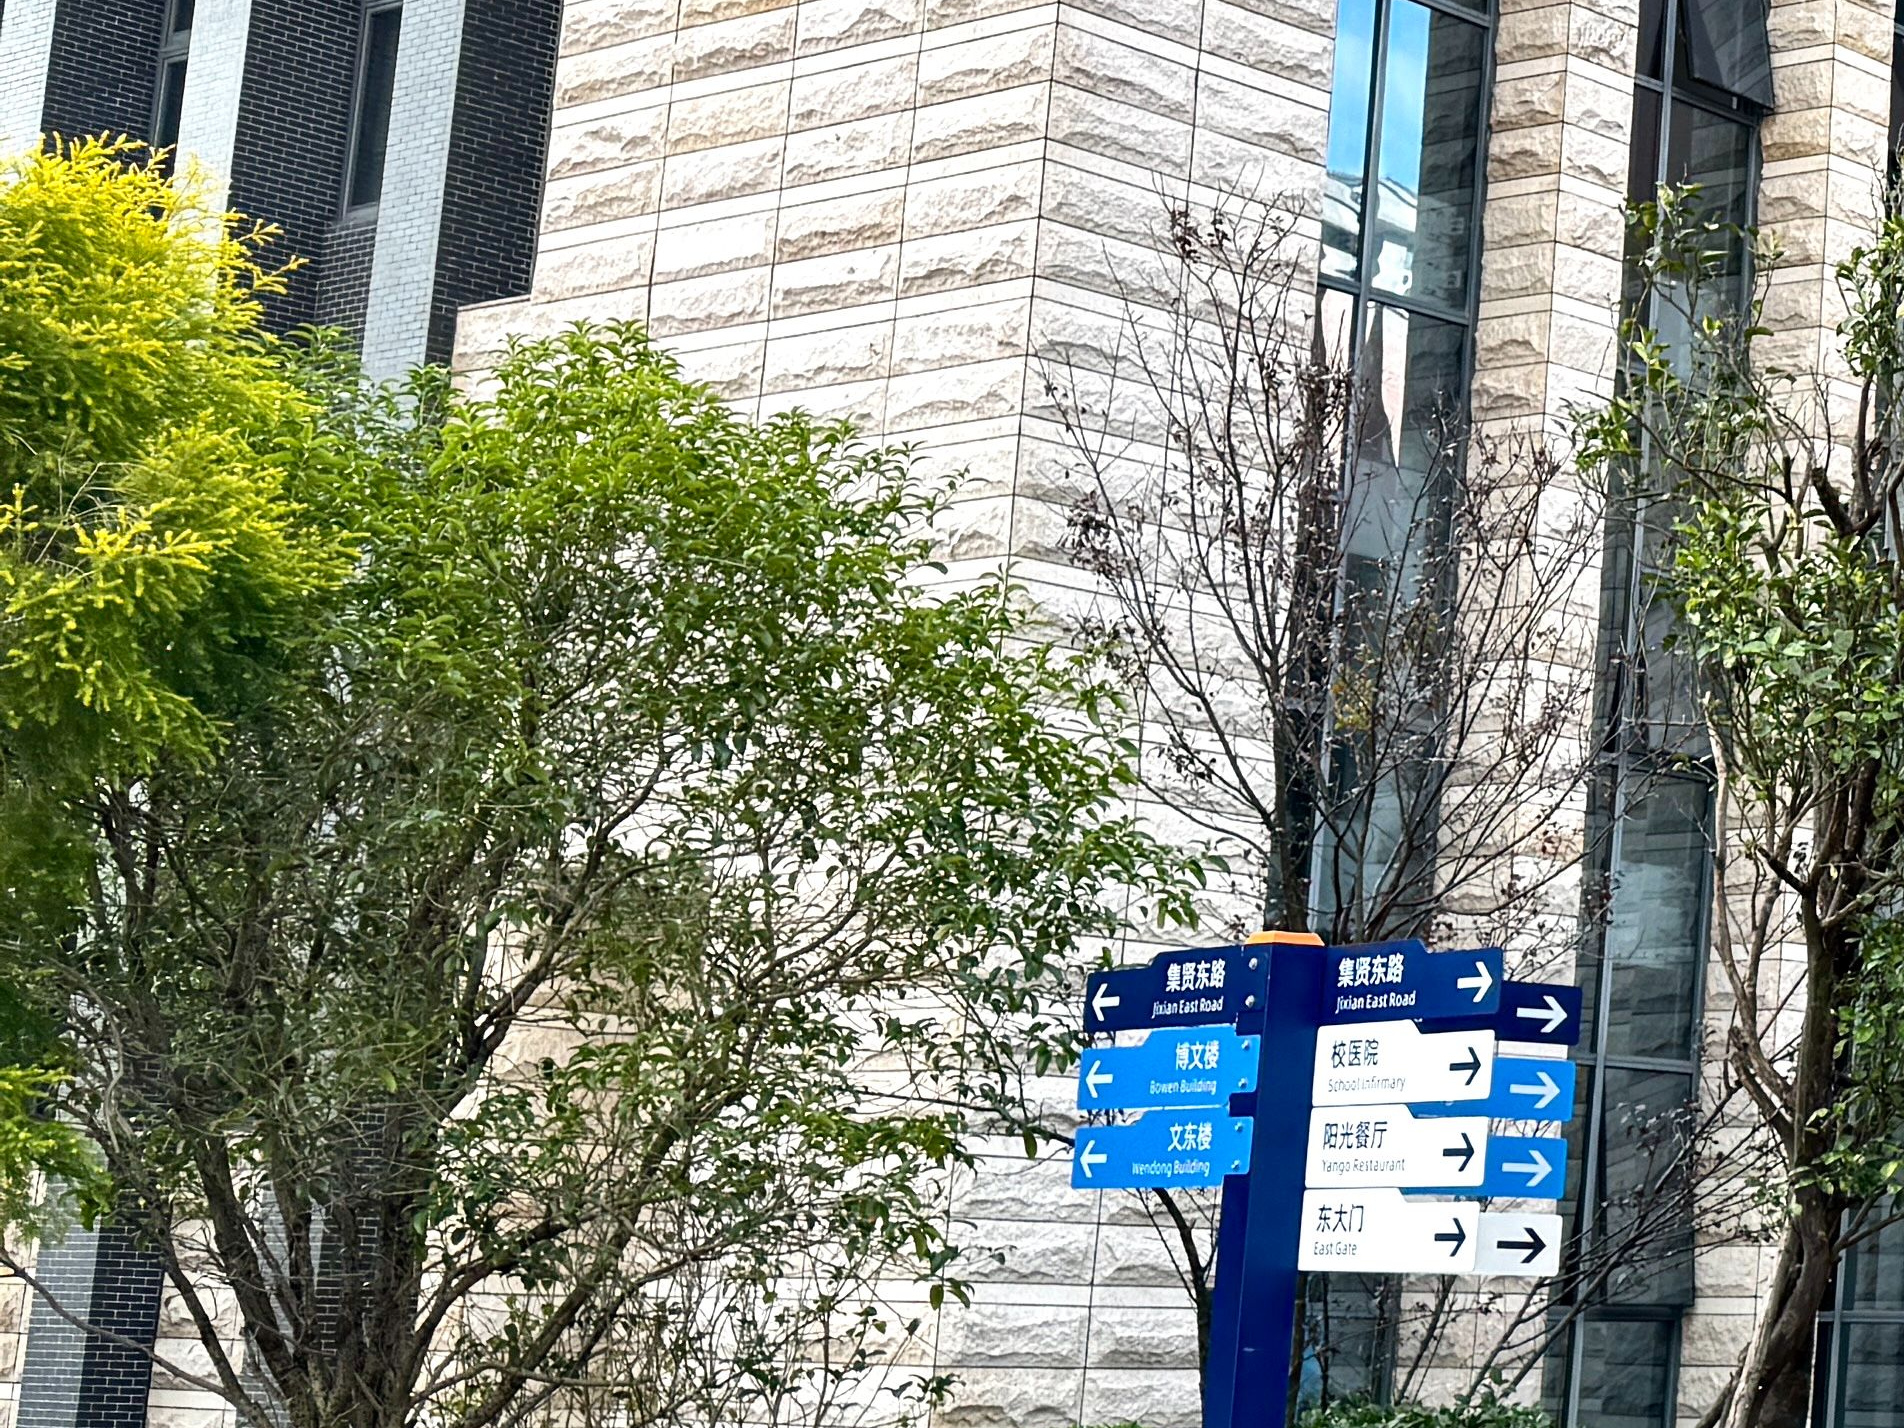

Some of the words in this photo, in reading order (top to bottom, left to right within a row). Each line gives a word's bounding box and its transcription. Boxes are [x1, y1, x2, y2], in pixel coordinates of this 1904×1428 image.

[1165, 958, 1226, 992] 集贤东路
[1337, 952, 1405, 988] 集贤东路
[1151, 1000, 1178, 1019] Jixian
[1179, 999, 1198, 1014] East
[1200, 996, 1224, 1012] Road
[1335, 995, 1364, 1014] Jixian
[1366, 993, 1387, 1009] East
[1389, 990, 1417, 1007] Road
[1175, 1040, 1220, 1070] 博文楼
[1331, 1038, 1379, 1068] 校医院
[1150, 1080, 1179, 1095] Bowen
[1180, 1077, 1217, 1095] Building
[1328, 1077, 1360, 1092] School
[1167, 1121, 1213, 1152] 文东楼
[1322, 1121, 1388, 1150] 阳光餐厅
[1132, 1160, 1172, 1178] Wendong
[1173, 1158, 1210, 1177] Building
[1322, 1159, 1350, 1175] Yango
[1353, 1158, 1405, 1172] Restaurant
[1316, 1203, 1364, 1233] 东大门
[1314, 1241, 1333, 1255] East
[1336, 1241, 1357, 1255] Gate
